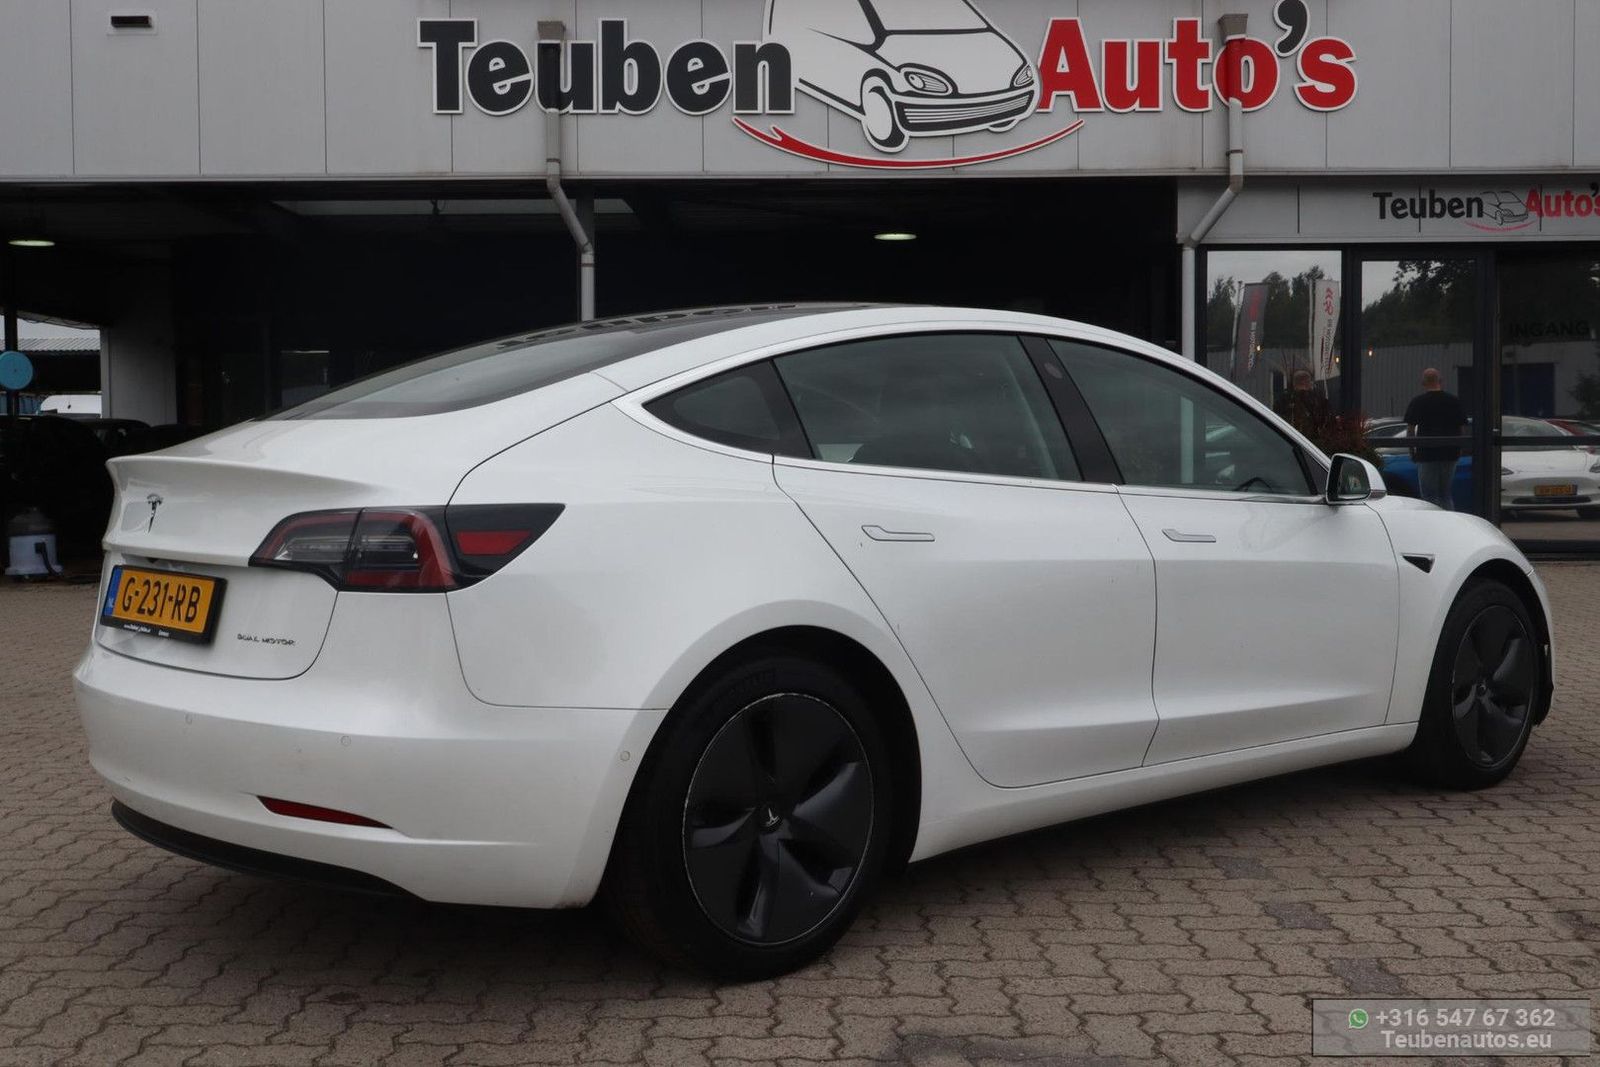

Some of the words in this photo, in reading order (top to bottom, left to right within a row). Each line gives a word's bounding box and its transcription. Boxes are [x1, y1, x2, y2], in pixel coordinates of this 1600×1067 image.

[418, 18, 794, 115] Teuben
[1036, 0, 1357, 112] Auto's
[1373, 189, 1483, 219] Teuben
[1509, 320, 1590, 336] INGANG
[122, 576, 201, 623] G-231-RB
[237, 633, 259, 643] DUAL
[262, 637, 296, 646] MOTOR
